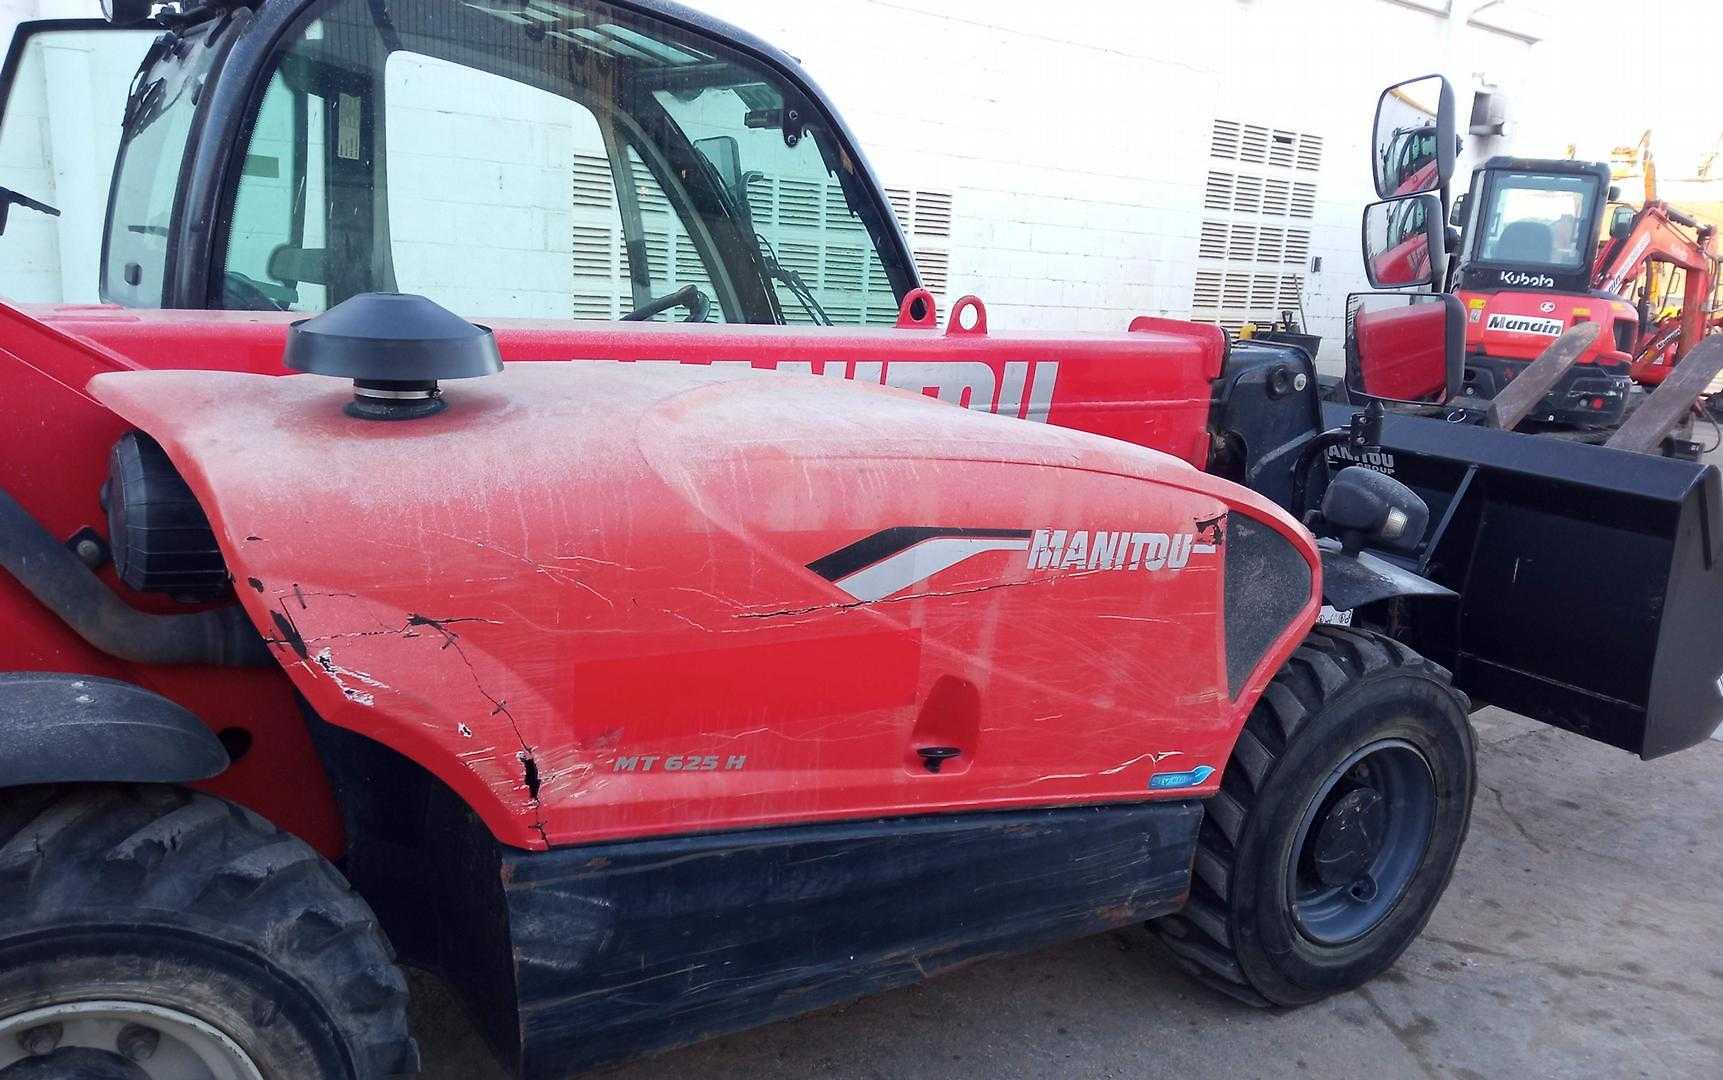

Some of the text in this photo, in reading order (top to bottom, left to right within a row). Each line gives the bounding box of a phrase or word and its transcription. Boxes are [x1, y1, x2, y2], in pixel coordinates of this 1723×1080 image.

[1500, 271, 1554, 288] Kubota
[1027, 529, 1193, 571] MANITOU
[613, 755, 746, 773] MT 625 H
